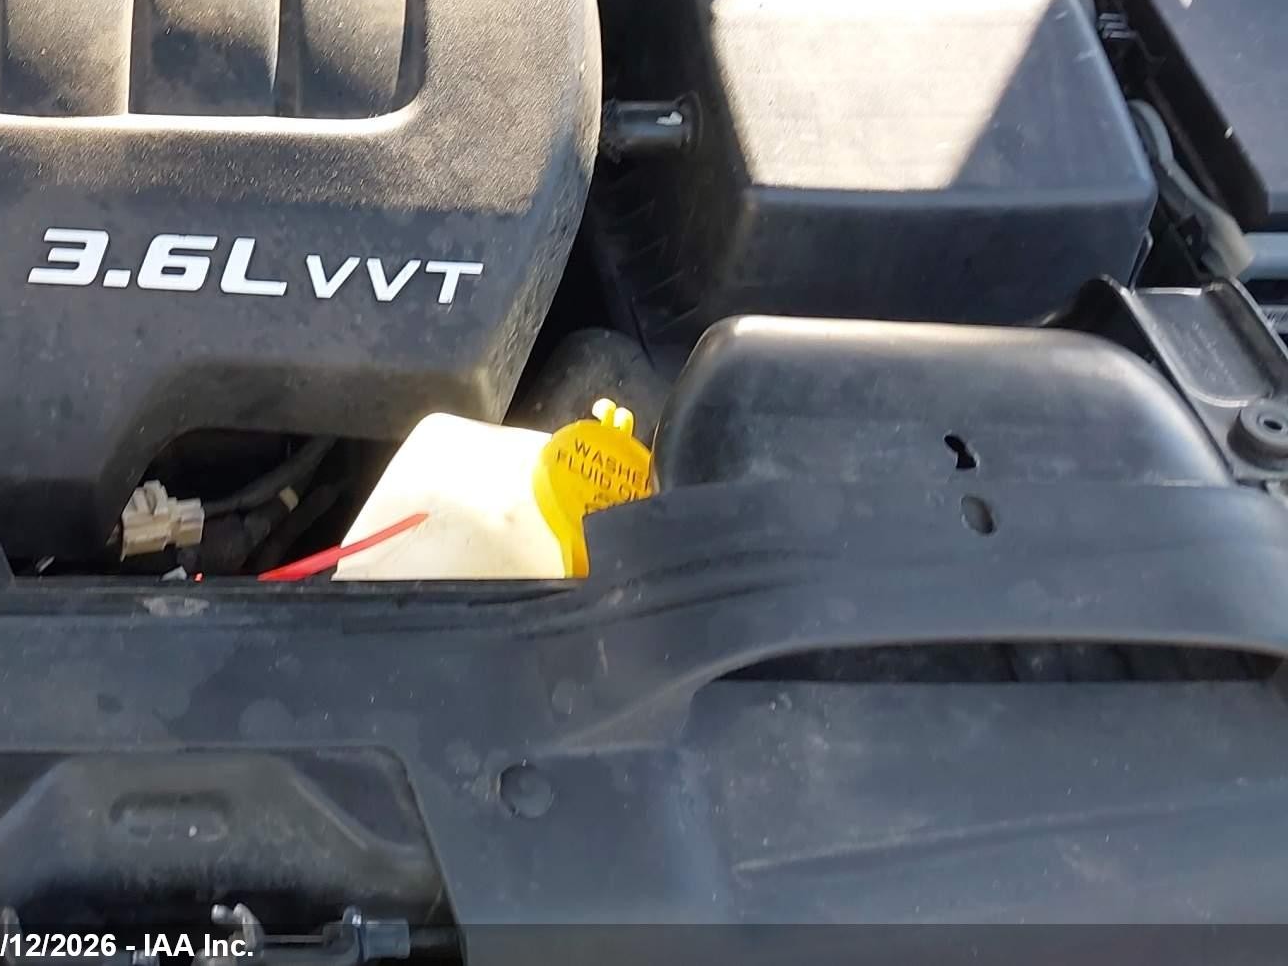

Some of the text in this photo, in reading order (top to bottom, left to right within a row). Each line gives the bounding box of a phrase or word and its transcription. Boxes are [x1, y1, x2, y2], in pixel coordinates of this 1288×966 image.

[27, 227, 484, 304] 3.6L VVT
[574, 438, 650, 492] WASHE
